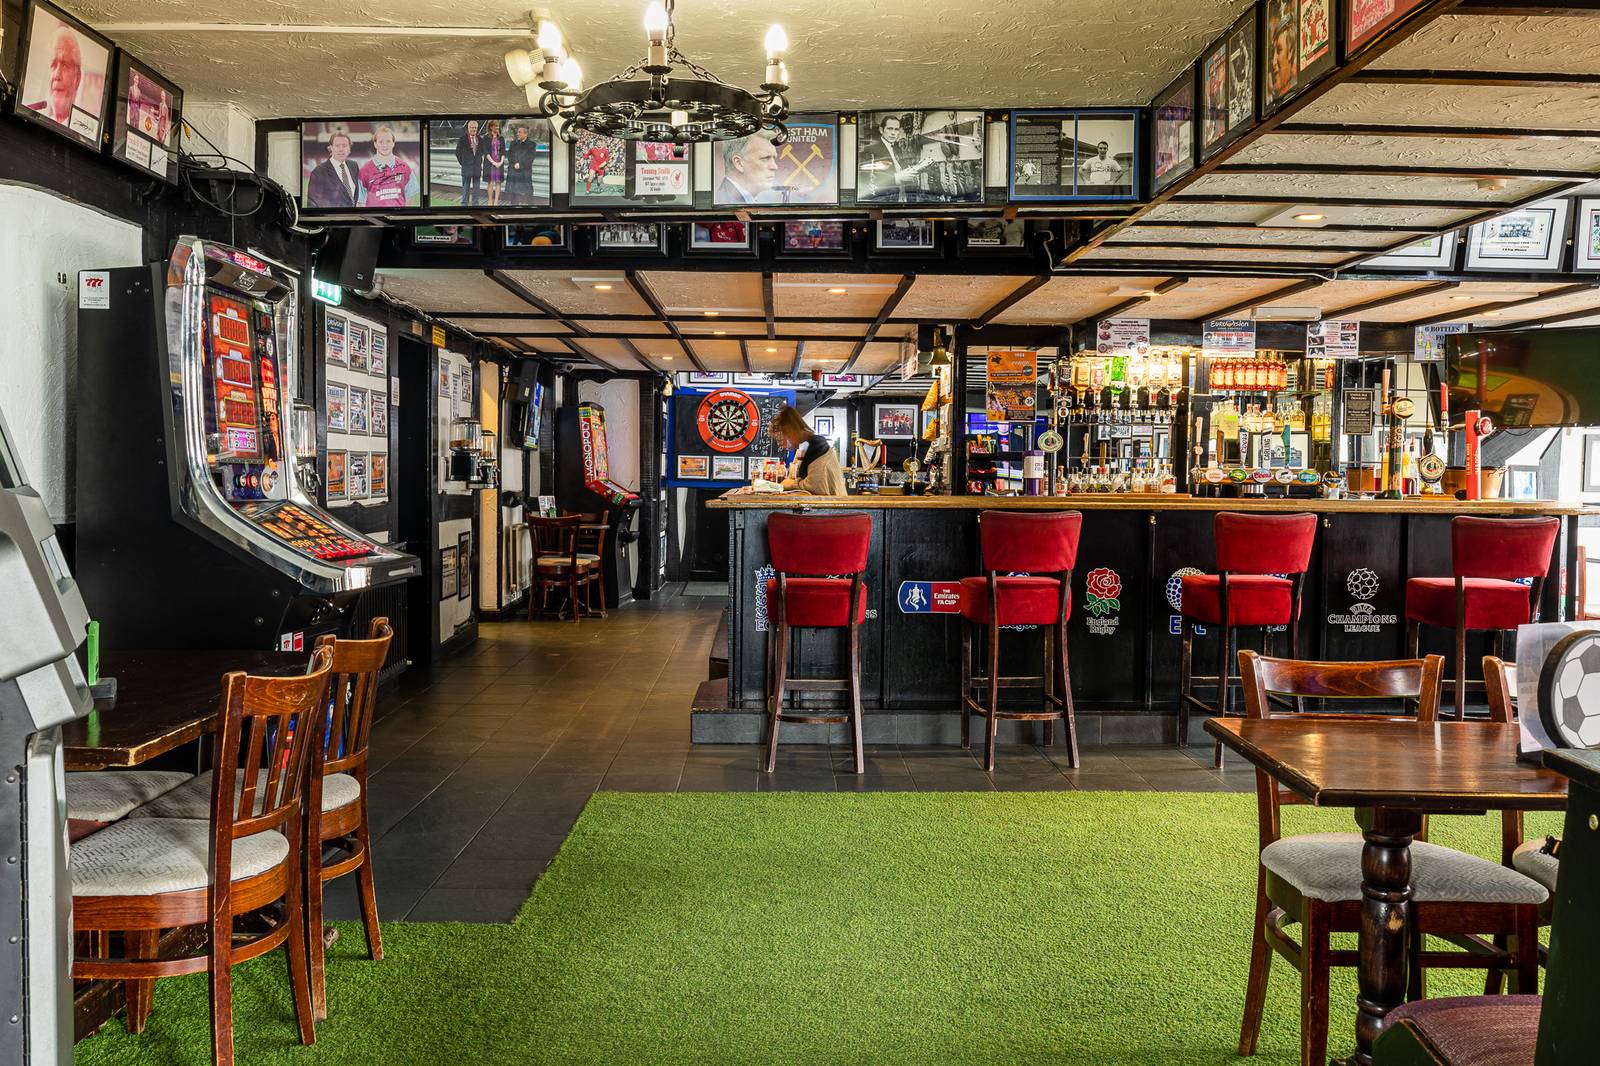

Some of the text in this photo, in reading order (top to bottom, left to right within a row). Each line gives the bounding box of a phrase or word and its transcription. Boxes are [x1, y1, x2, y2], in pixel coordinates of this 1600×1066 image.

[803, 127, 828, 137] HAM
[786, 135, 817, 143] UNITED
[85, 277, 104, 288] 777
[1431, 325, 1461, 333] BOTTLES
[581, 420, 594, 477] MONOPOLY
[1240, 433, 1248, 454] Coors
[1263, 438, 1271, 461] CARLING
[933, 592, 960, 600] Emirates
[1086, 616, 1119, 627] England
[1327, 614, 1397, 624] CHAMPIONS
[1089, 624, 1116, 635] Rugby
[1169, 615, 1207, 635] EL
[1344, 624, 1380, 632] LEAGUE
